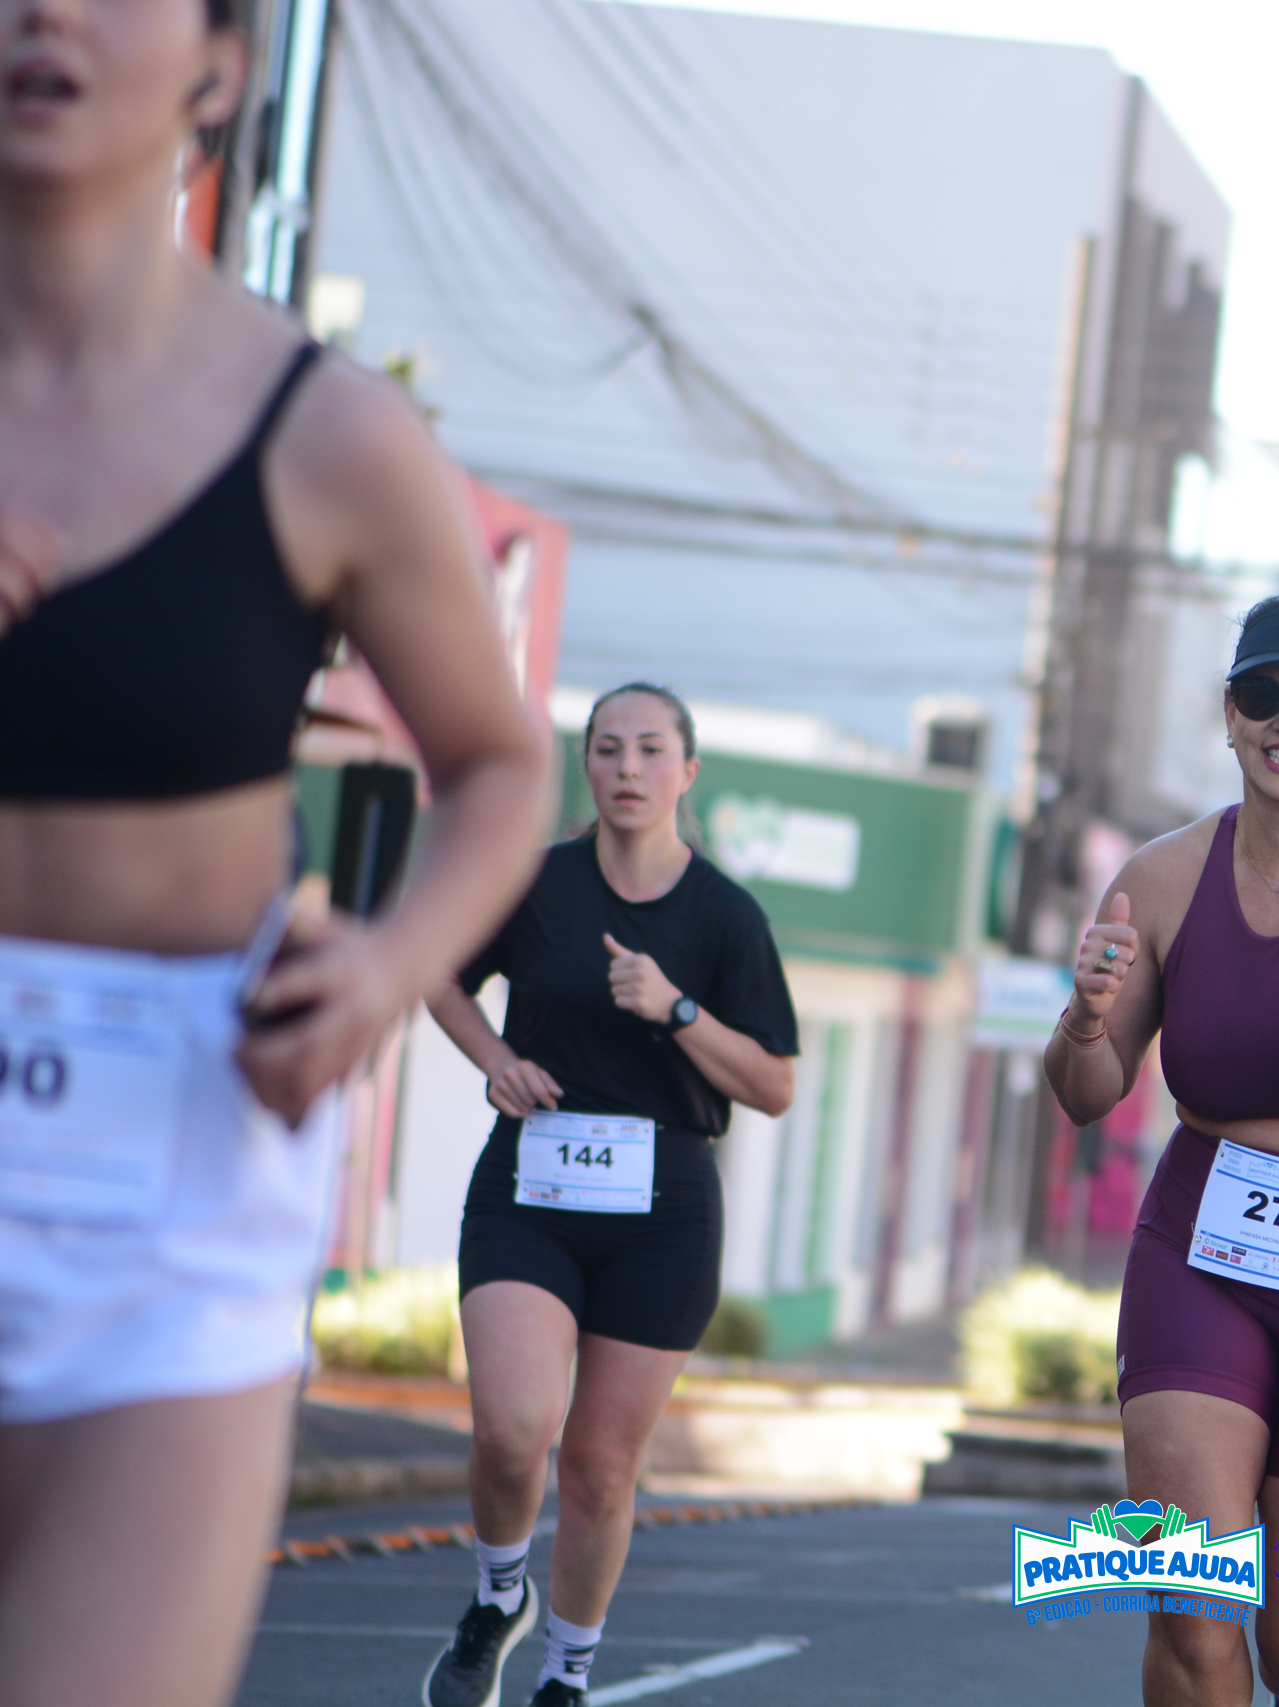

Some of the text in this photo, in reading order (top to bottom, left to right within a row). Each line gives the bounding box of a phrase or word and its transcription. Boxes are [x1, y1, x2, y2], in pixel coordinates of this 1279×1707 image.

[557, 1143, 615, 1169] 144
[1239, 1229, 1261, 1240] VANESSA
[1210, 1240, 1227, 1250] Sicredi
